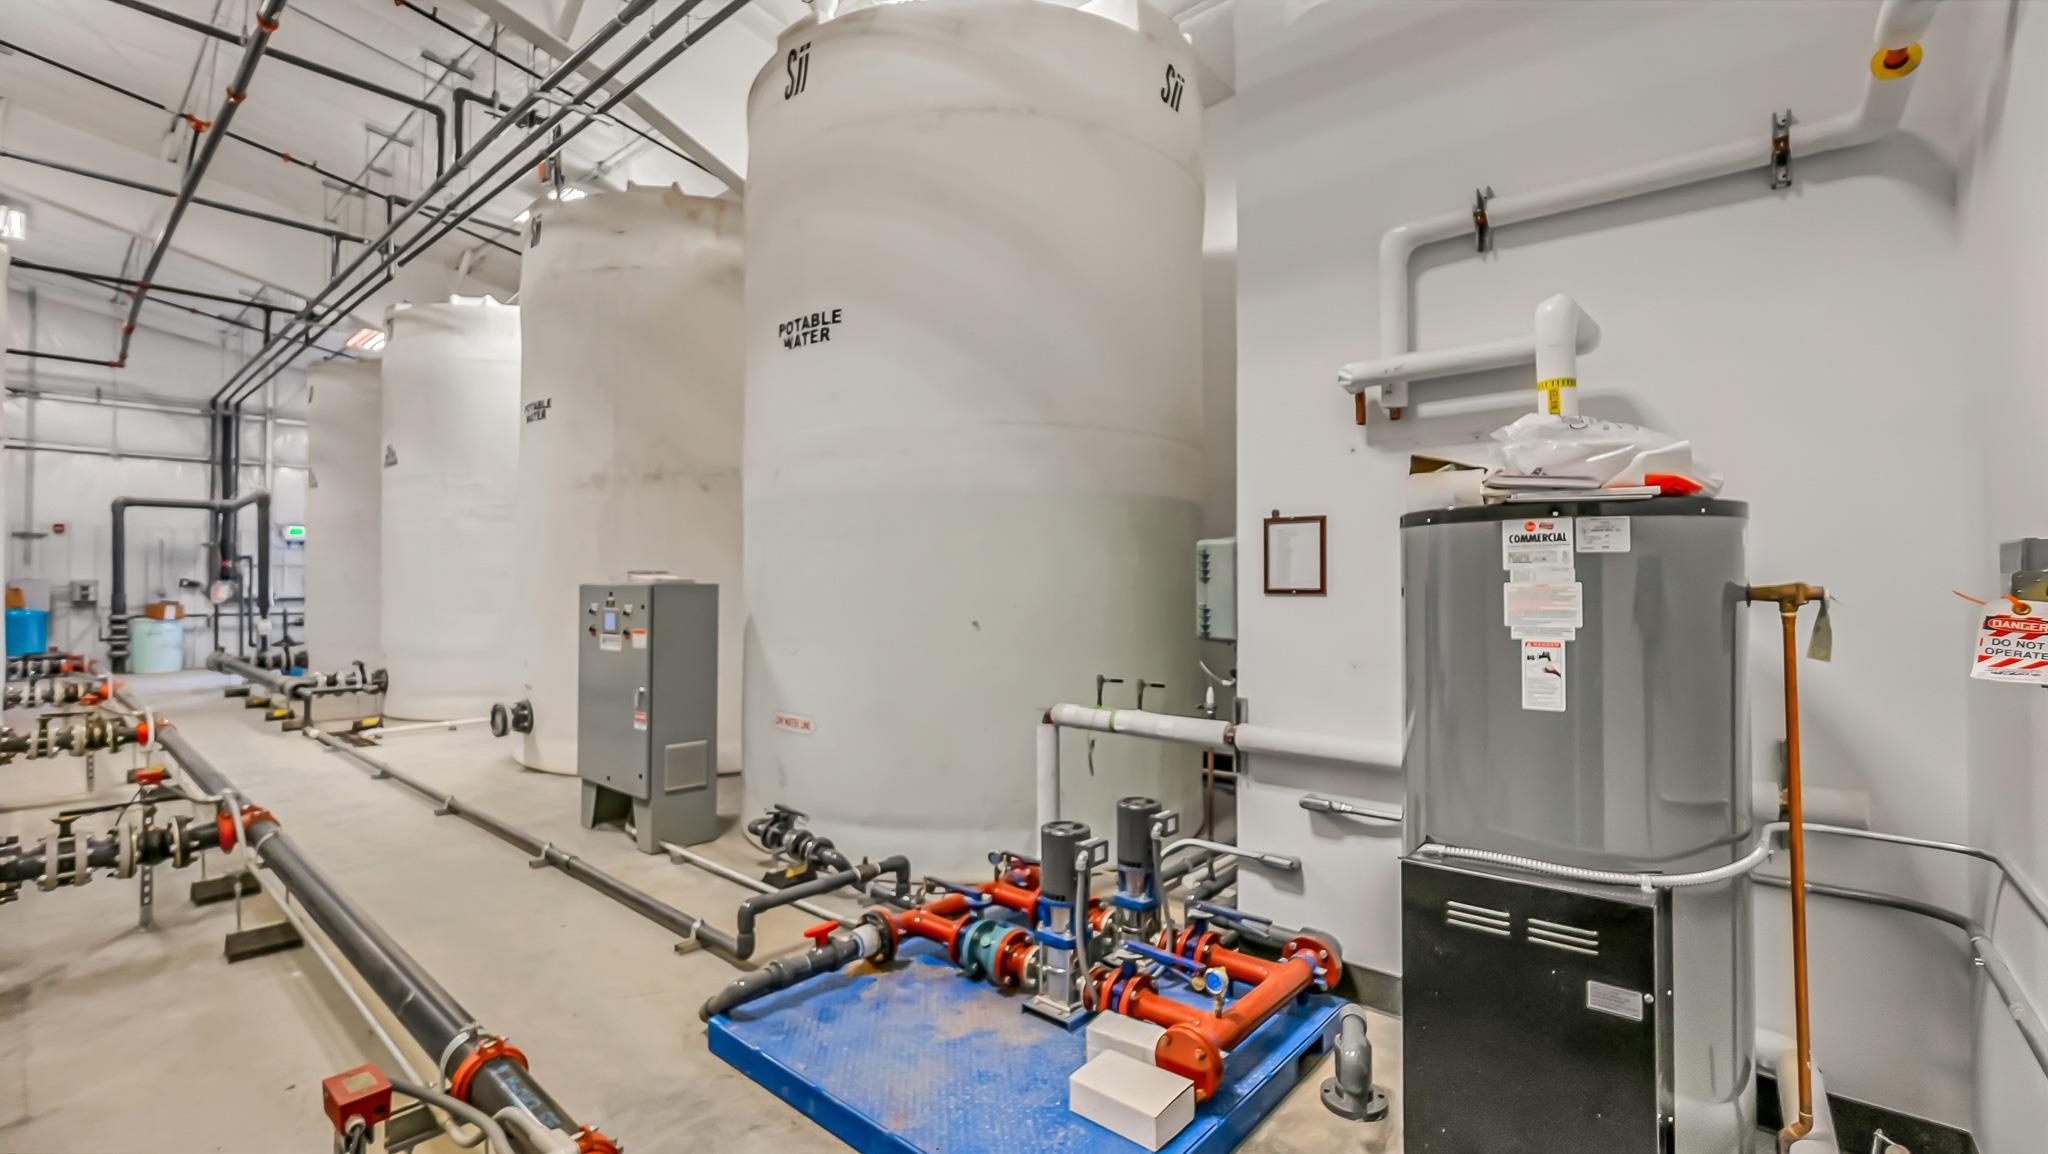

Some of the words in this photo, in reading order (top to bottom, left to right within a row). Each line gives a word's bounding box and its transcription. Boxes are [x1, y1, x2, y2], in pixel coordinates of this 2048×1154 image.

[778, 308, 842, 338] POTABLE
[784, 327, 830, 349] WATER
[1508, 532, 1567, 543] COMMERCIAL
[1991, 619, 2048, 632] DANGER
[1992, 638, 2011, 647] DO
[2016, 640, 2046, 650] NOT
[1984, 647, 2048, 660] OPERATE
